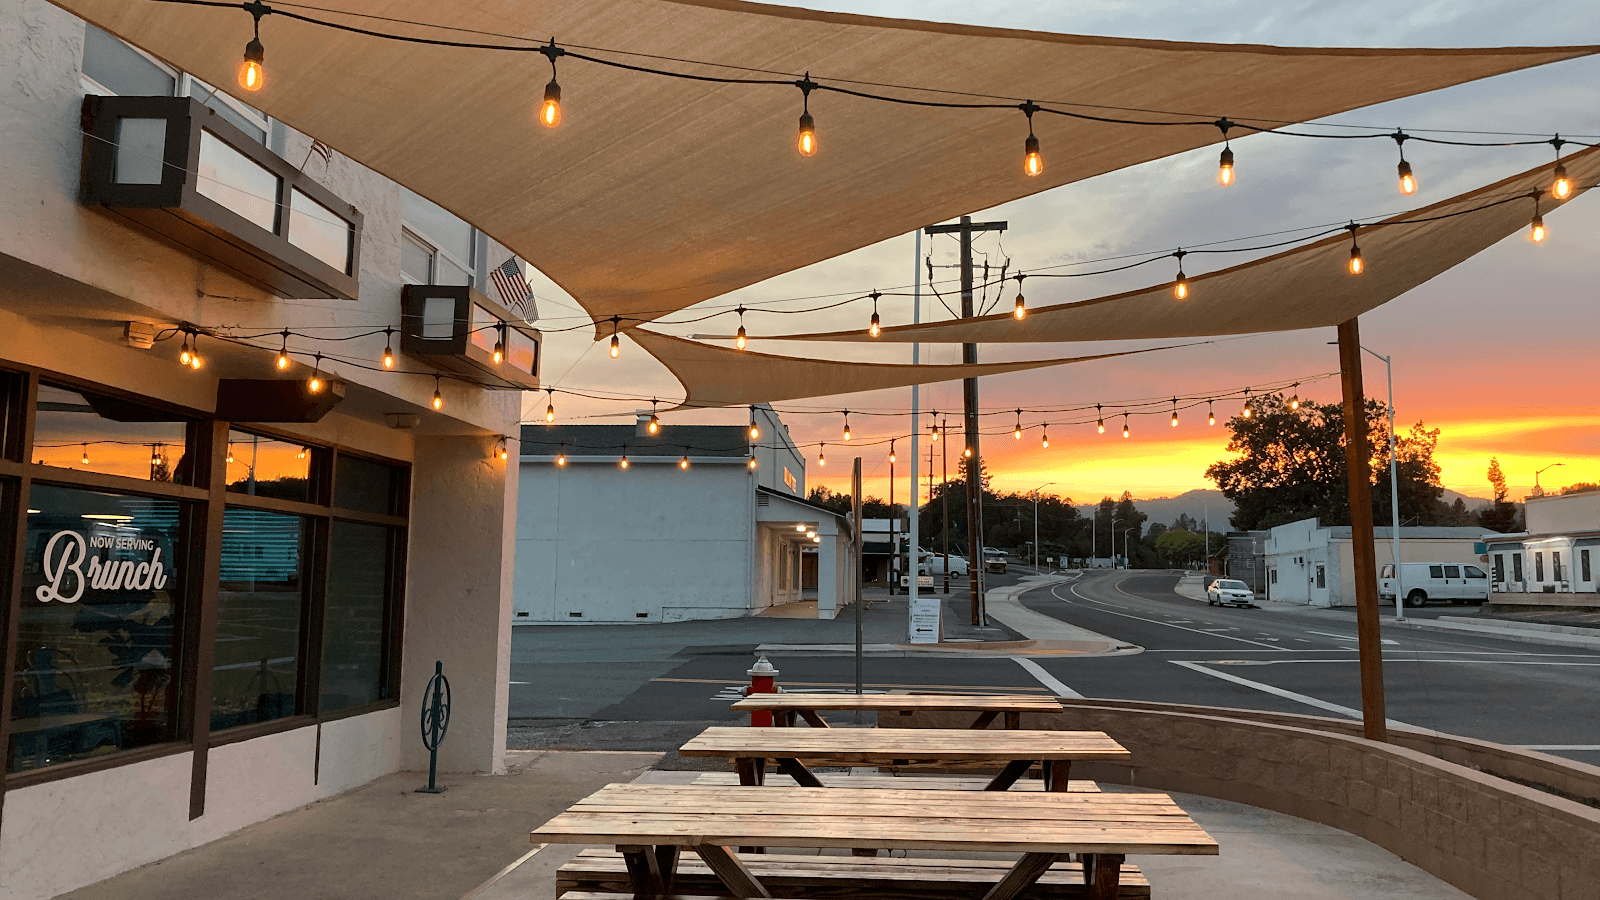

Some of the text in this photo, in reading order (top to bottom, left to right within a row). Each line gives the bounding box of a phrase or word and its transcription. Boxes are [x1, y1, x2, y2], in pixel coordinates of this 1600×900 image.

[90, 536, 154, 551] NOW SERVING
[35, 529, 168, 604] Brunch
